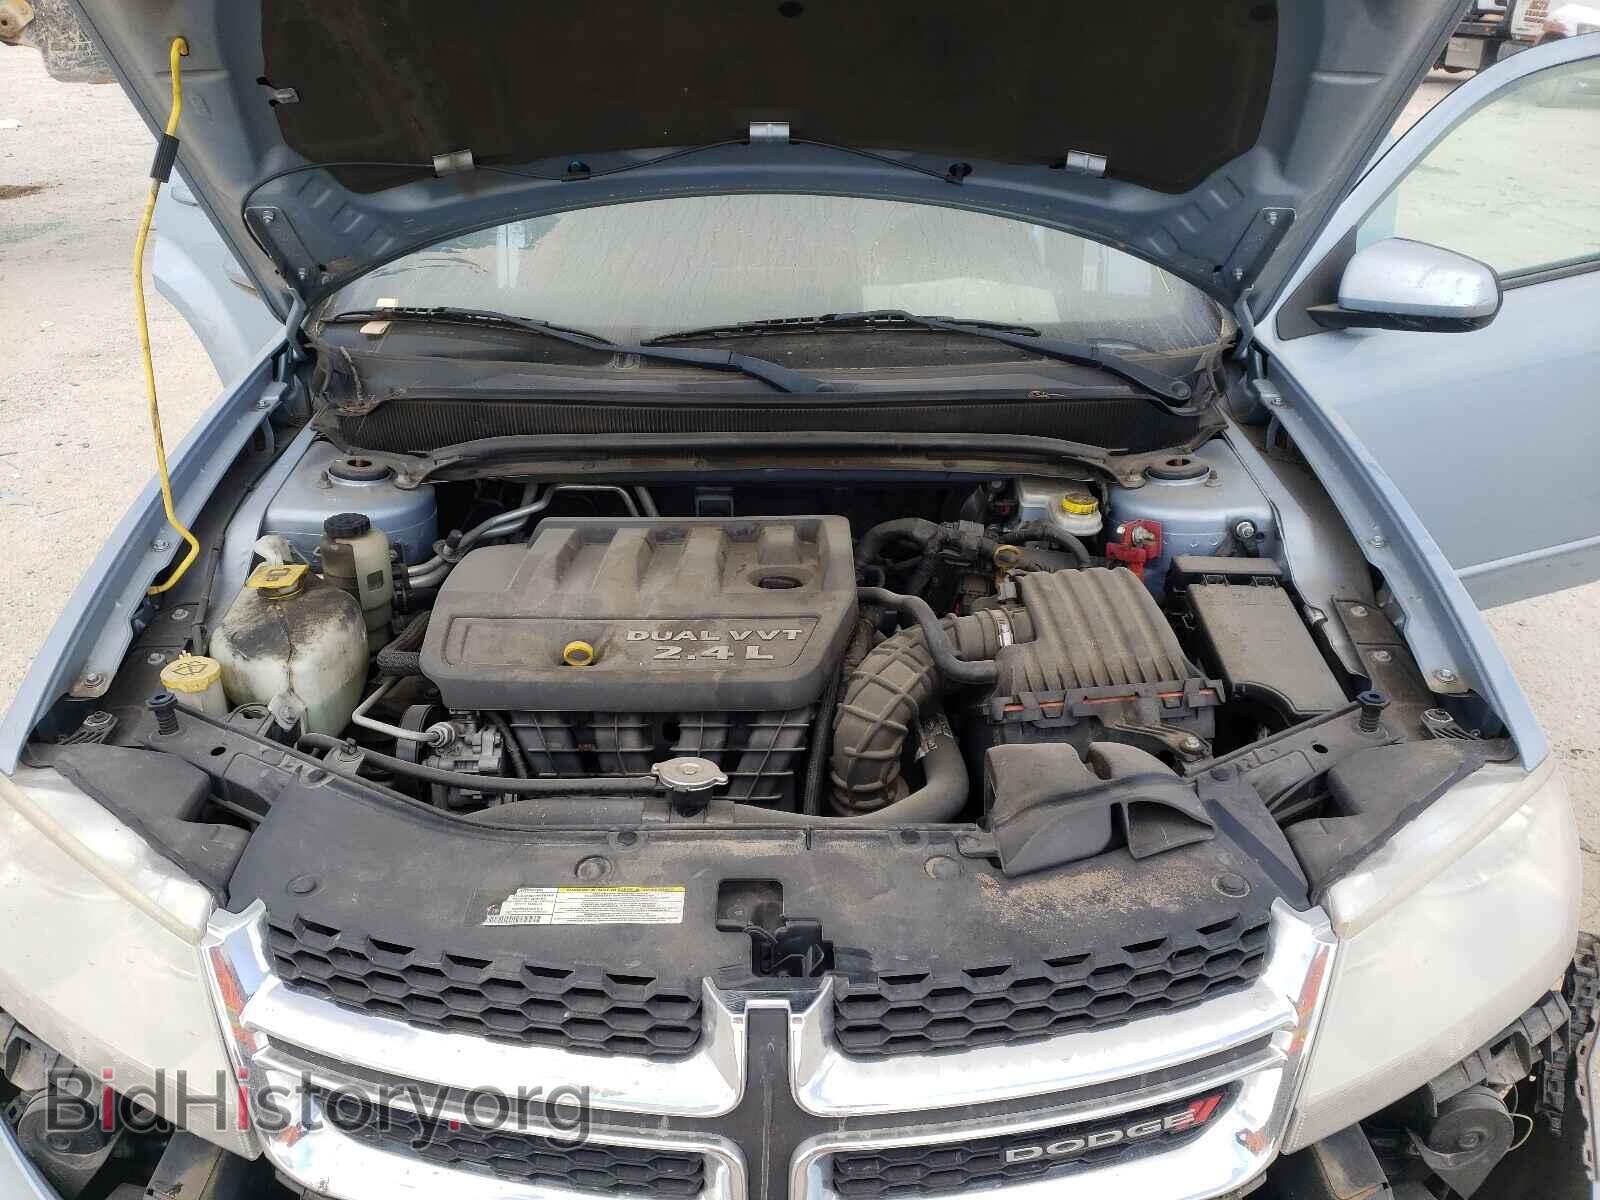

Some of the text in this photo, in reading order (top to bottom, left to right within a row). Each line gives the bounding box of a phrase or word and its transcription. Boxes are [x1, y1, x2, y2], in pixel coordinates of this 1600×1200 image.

[626, 629, 802, 641] DUAL VVT
[1006, 1109, 1196, 1163] DODGE
